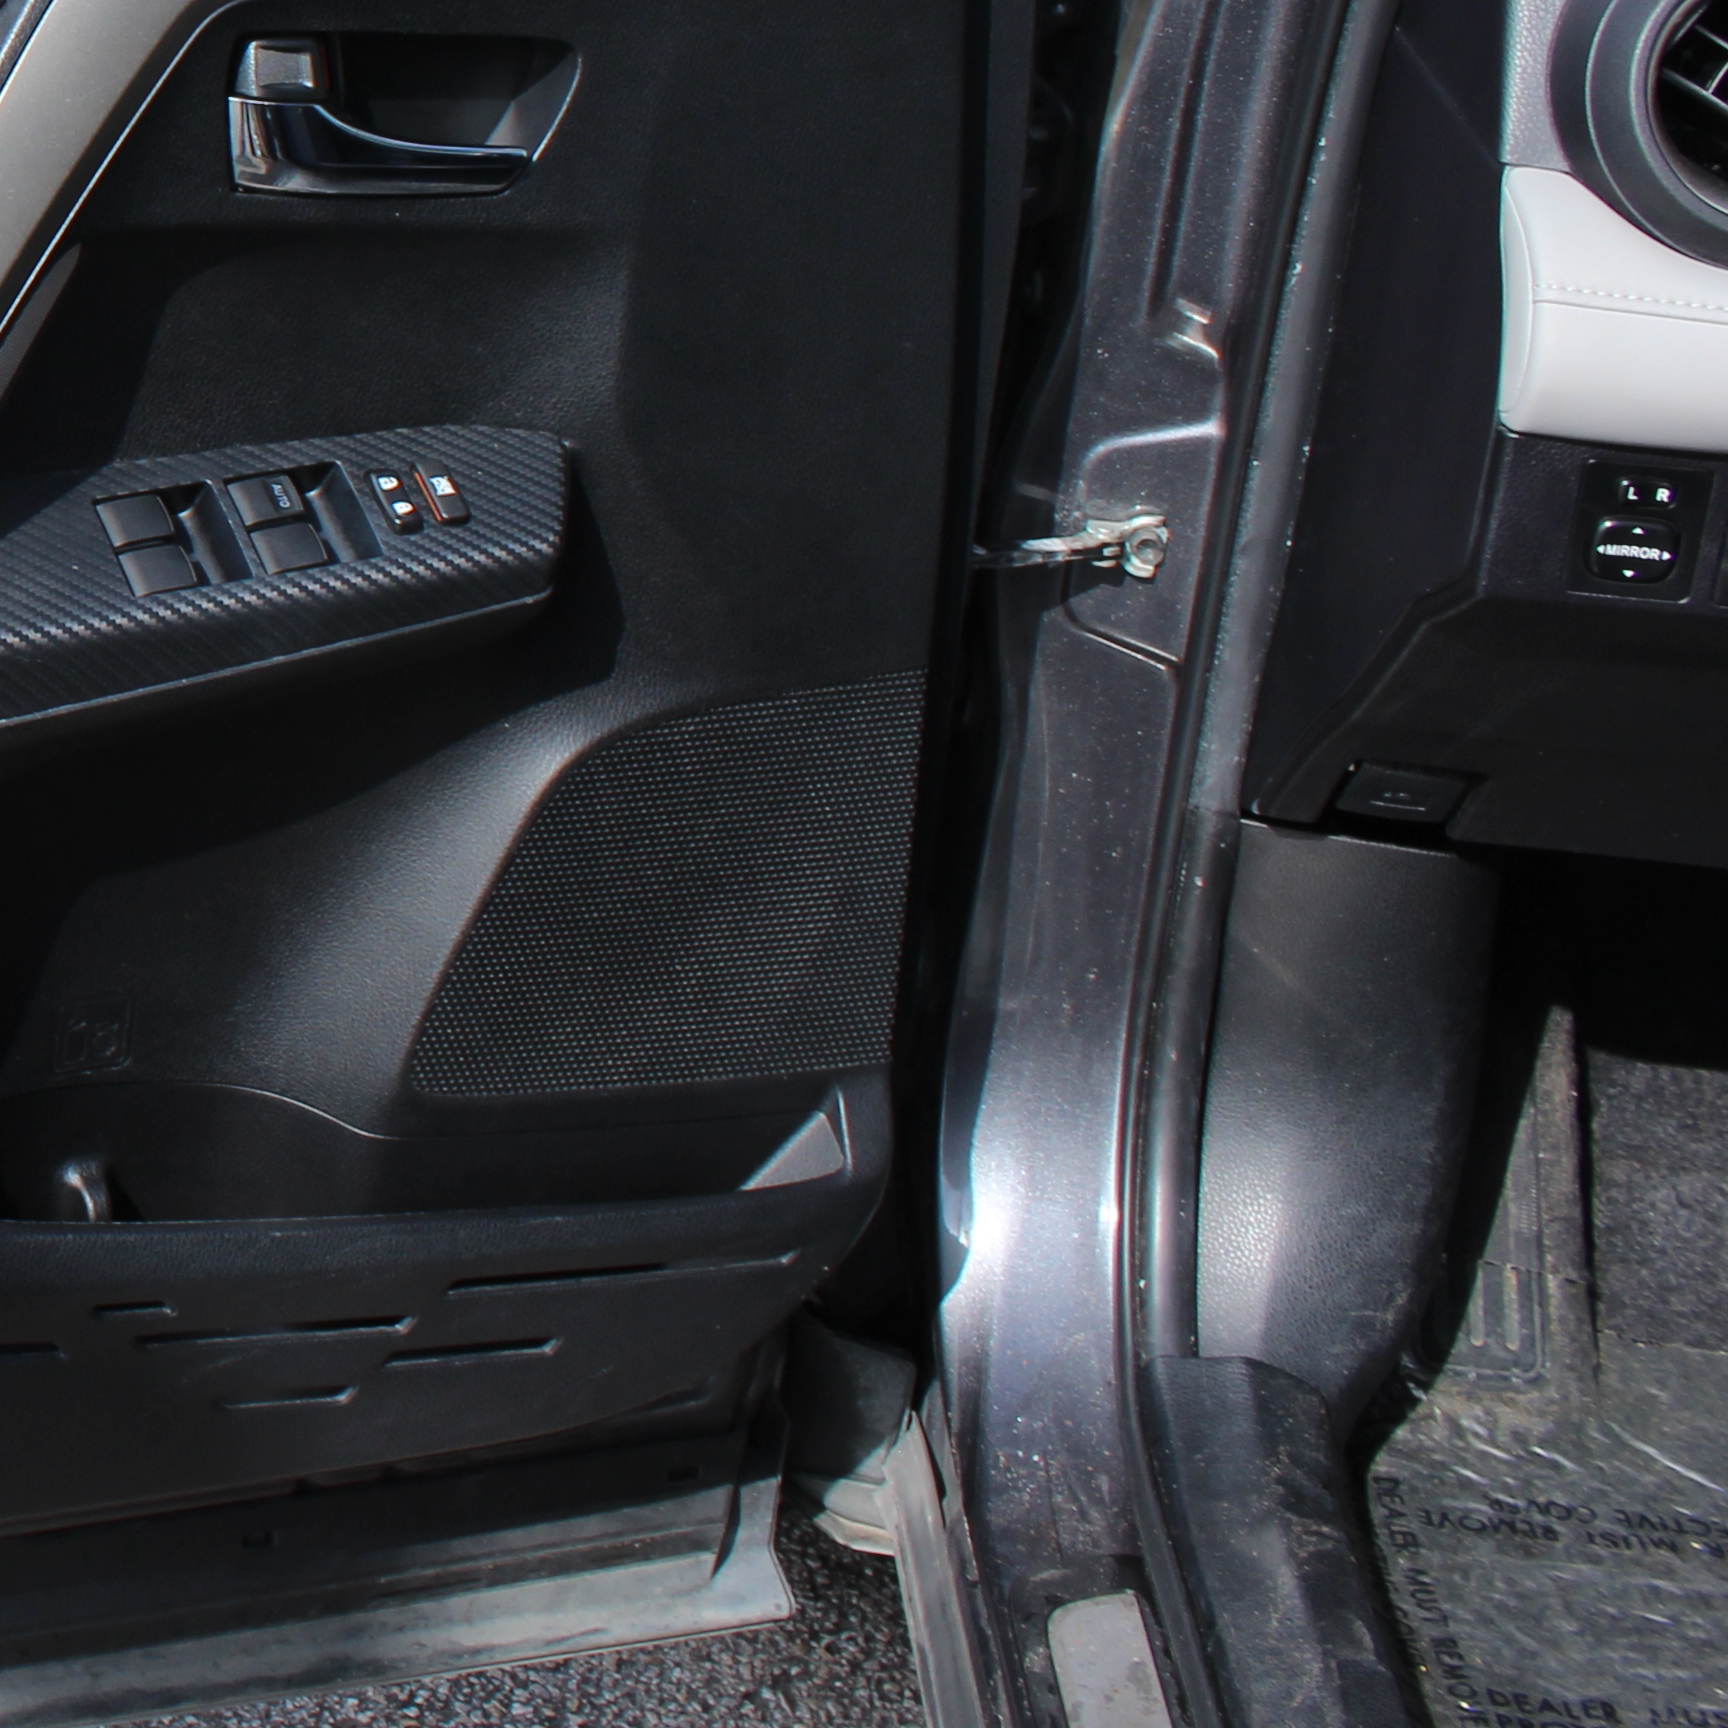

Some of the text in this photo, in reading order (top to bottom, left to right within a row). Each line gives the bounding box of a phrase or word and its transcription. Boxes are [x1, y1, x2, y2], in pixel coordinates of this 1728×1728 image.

[271, 483, 291, 508] AUTO
[1627, 486, 1671, 503] L R
[1605, 544, 1661, 560] MIRROR
[1416, 1505, 1561, 1544] REMOVE
[1486, 1687, 1623, 1725] DEALER
